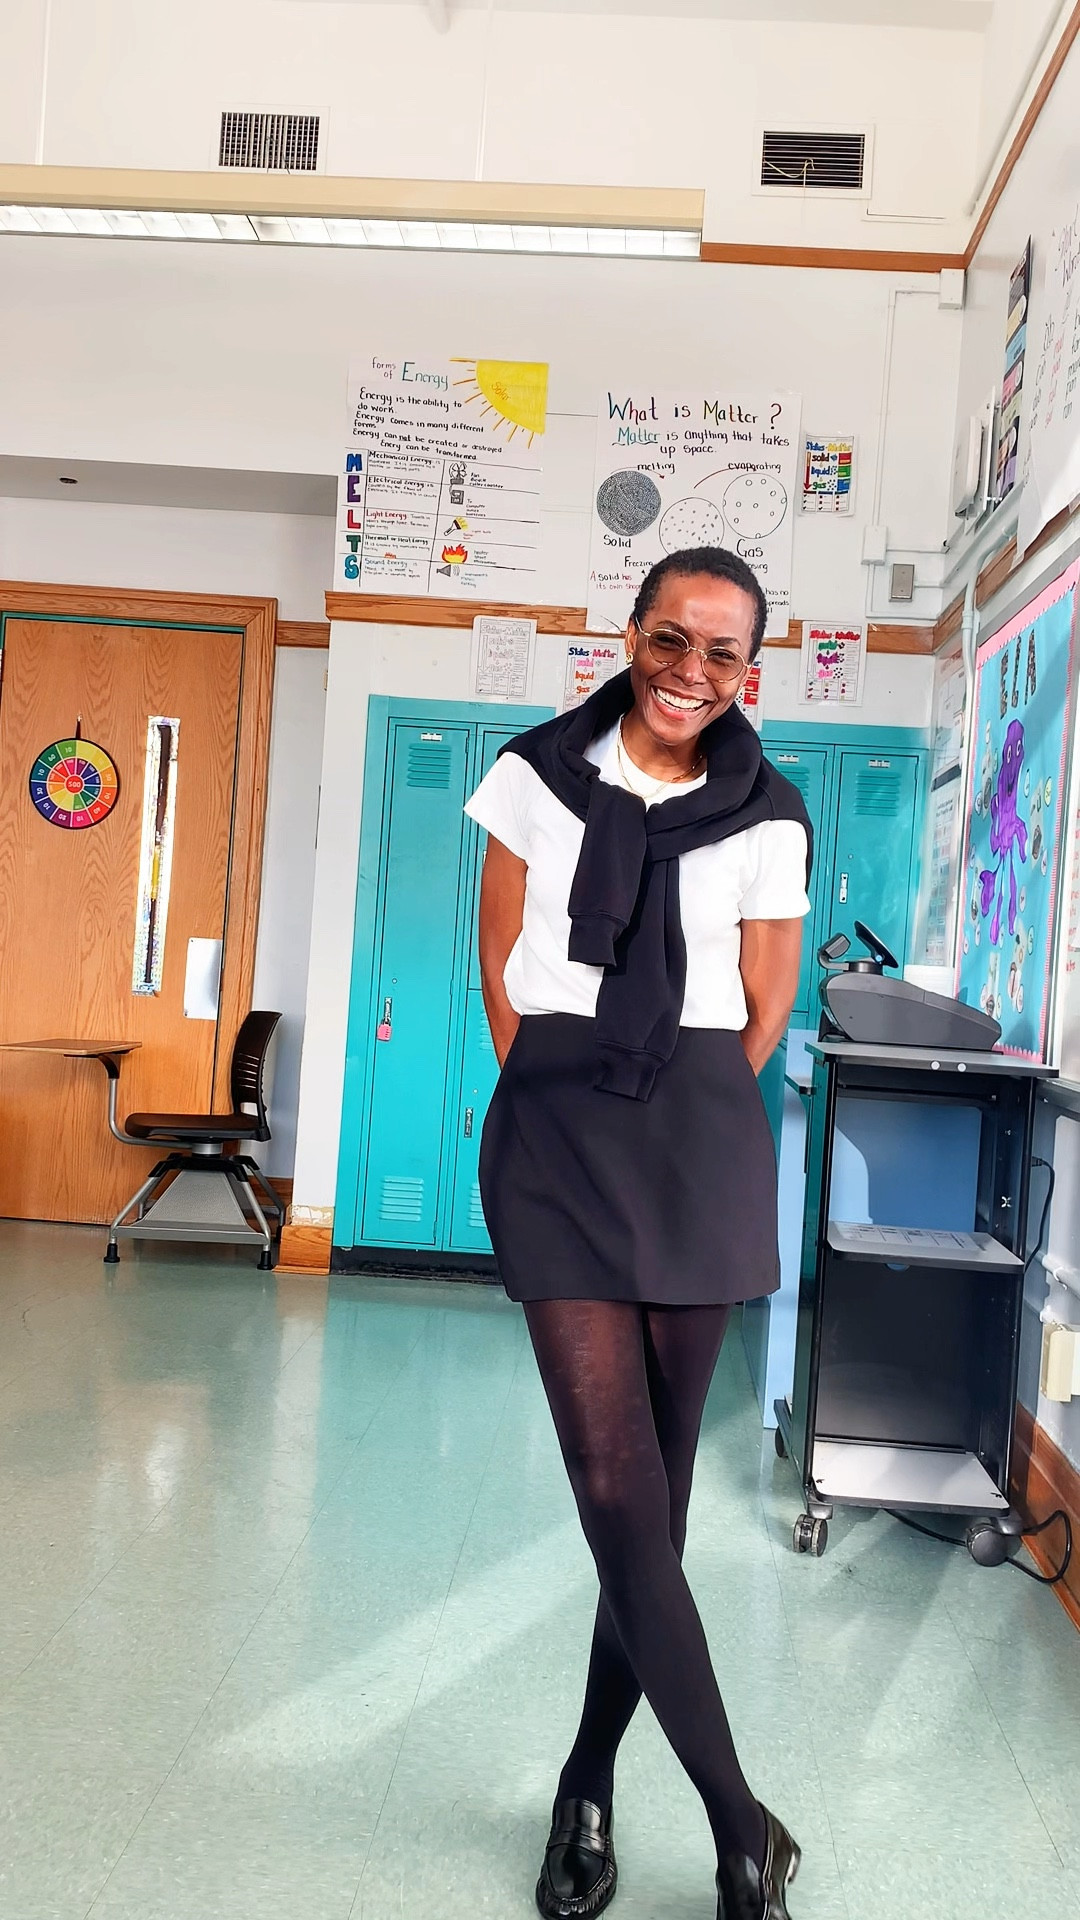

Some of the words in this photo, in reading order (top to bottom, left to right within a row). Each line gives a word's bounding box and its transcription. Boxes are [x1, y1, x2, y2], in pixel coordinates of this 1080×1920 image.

[372, 356, 396, 369] forms
[383, 370, 393, 379] of
[402, 361, 449, 391] Energy
[359, 386, 392, 406] Energy
[408, 396, 421, 404] the
[422, 398, 449, 413] ability
[453, 400, 462, 408] to
[357, 402, 368, 410] do
[607, 392, 659, 426] What
[673, 403, 691, 418] is
[703, 399, 759, 426] Matter
[770, 402, 782, 430] ?
[356, 411, 385, 424] Energy
[426, 422, 449, 432] many
[451, 423, 484, 433] different
[352, 428, 380, 439] Energy
[428, 439, 458, 448] created
[615, 426, 661, 446] Matter
[666, 431, 679, 441] is
[732, 429, 753, 442] that
[760, 432, 790, 447] takes
[660, 445, 676, 459] up
[811, 452, 830, 462] solid
[346, 453, 363, 472] M
[637, 462, 676, 474] melting
[728, 462, 782, 474] evaporating
[811, 466, 831, 478] liquid
[368, 476, 403, 485] Electrical
[812, 481, 826, 490] gas
[347, 475, 361, 502] E
[347, 509, 361, 529] L
[366, 508, 383, 520] Light
[384, 511, 407, 520] Energy
[346, 535, 361, 553] T
[603, 534, 632, 549] Solid
[736, 538, 764, 558] Gas
[364, 557, 385, 565] Sound
[386, 559, 408, 568] Energy
[590, 570, 596, 581] A
[765, 587, 779, 595] has
[568, 647, 590, 656] States
[592, 649, 617, 659] Matter
[575, 670, 595, 682] liquid
[576, 685, 590, 694] gas
